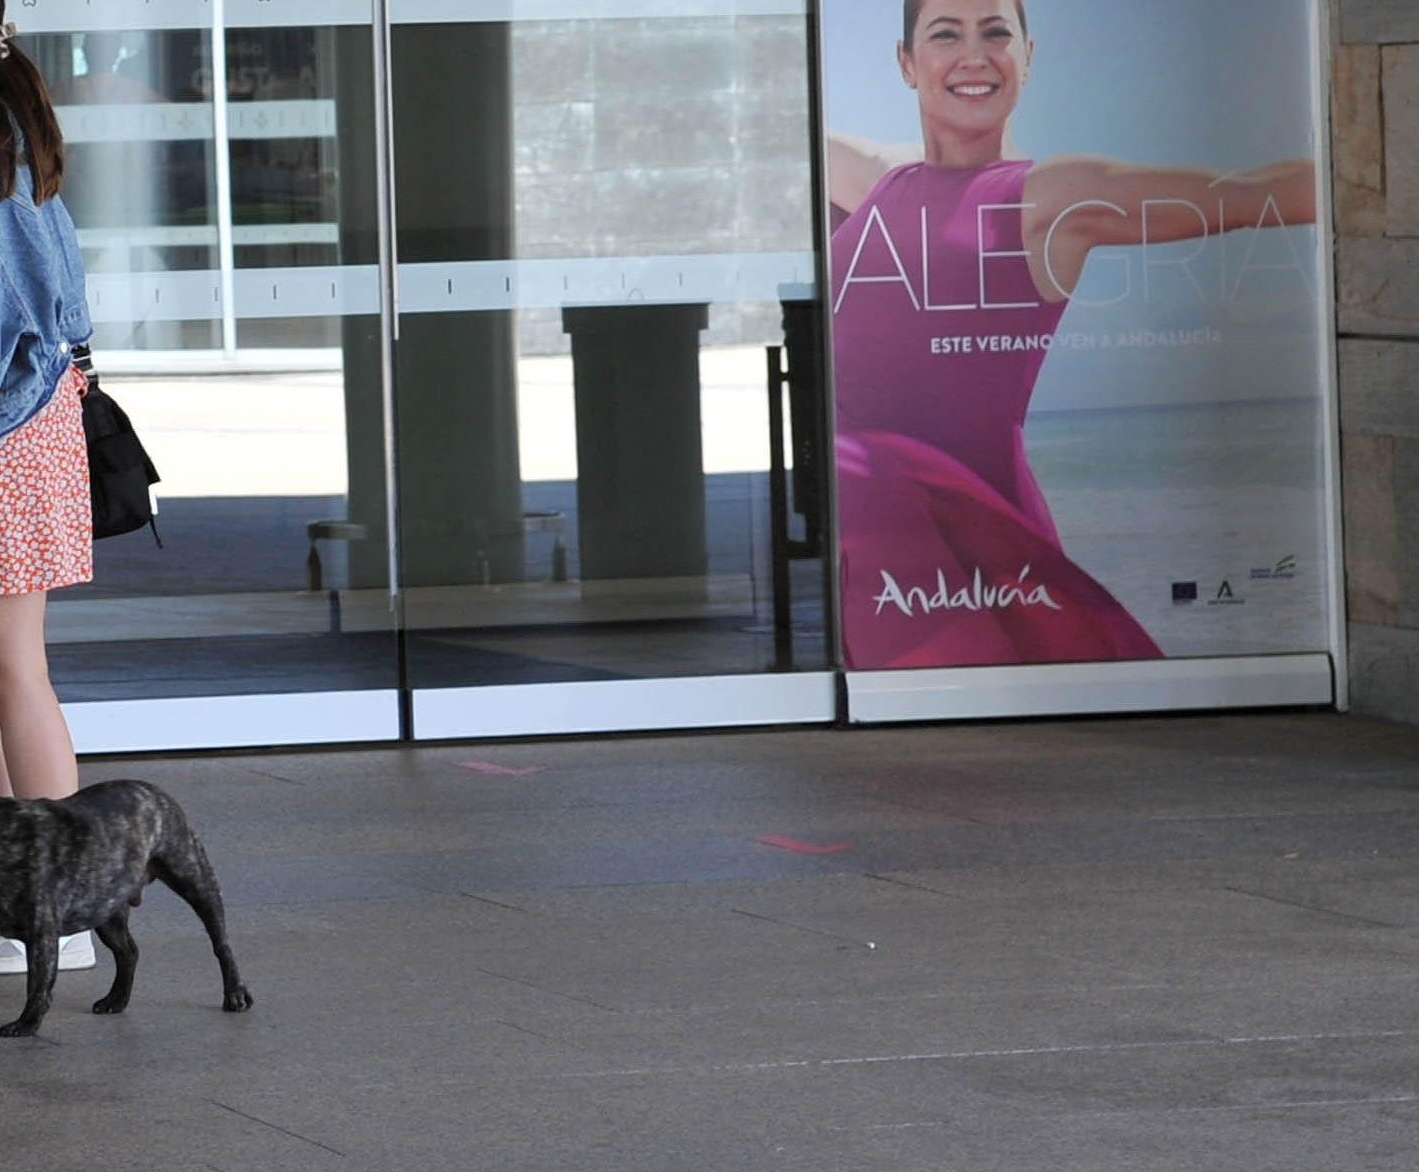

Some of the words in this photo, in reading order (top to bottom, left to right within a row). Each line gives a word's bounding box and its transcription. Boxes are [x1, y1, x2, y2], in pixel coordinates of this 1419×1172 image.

[833, 169, 1317, 315] ALEGRÍA
[930, 336, 973, 355] ESTE
[976, 334, 1054, 352] VERANO
[874, 564, 1062, 617] Andalucía
